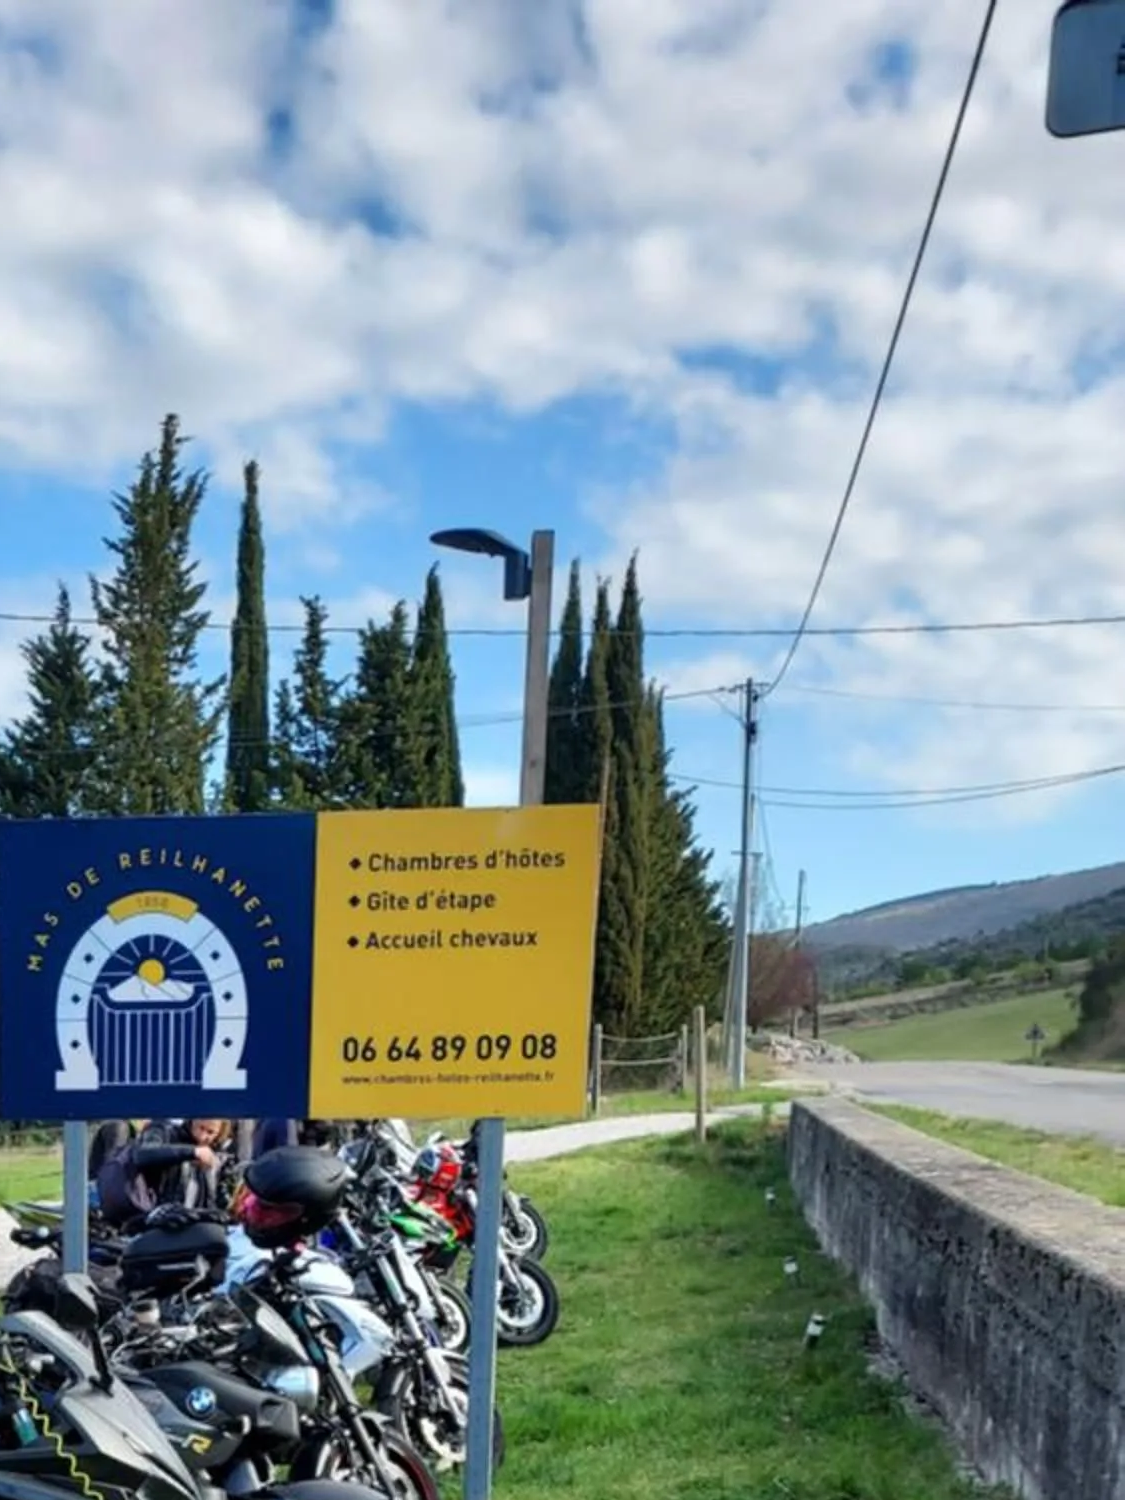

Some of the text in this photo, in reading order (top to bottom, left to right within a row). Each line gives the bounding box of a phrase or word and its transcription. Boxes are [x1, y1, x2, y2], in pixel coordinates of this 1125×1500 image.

[368, 848, 566, 872] Chambres d'hôtes
[27, 848, 284, 972] MAS DE REILHANETTE
[366, 888, 496, 912] Gîte d'étape
[365, 929, 538, 949] Accueil chevaux
[342, 1033, 557, 1062] 06 64 89 09 08
